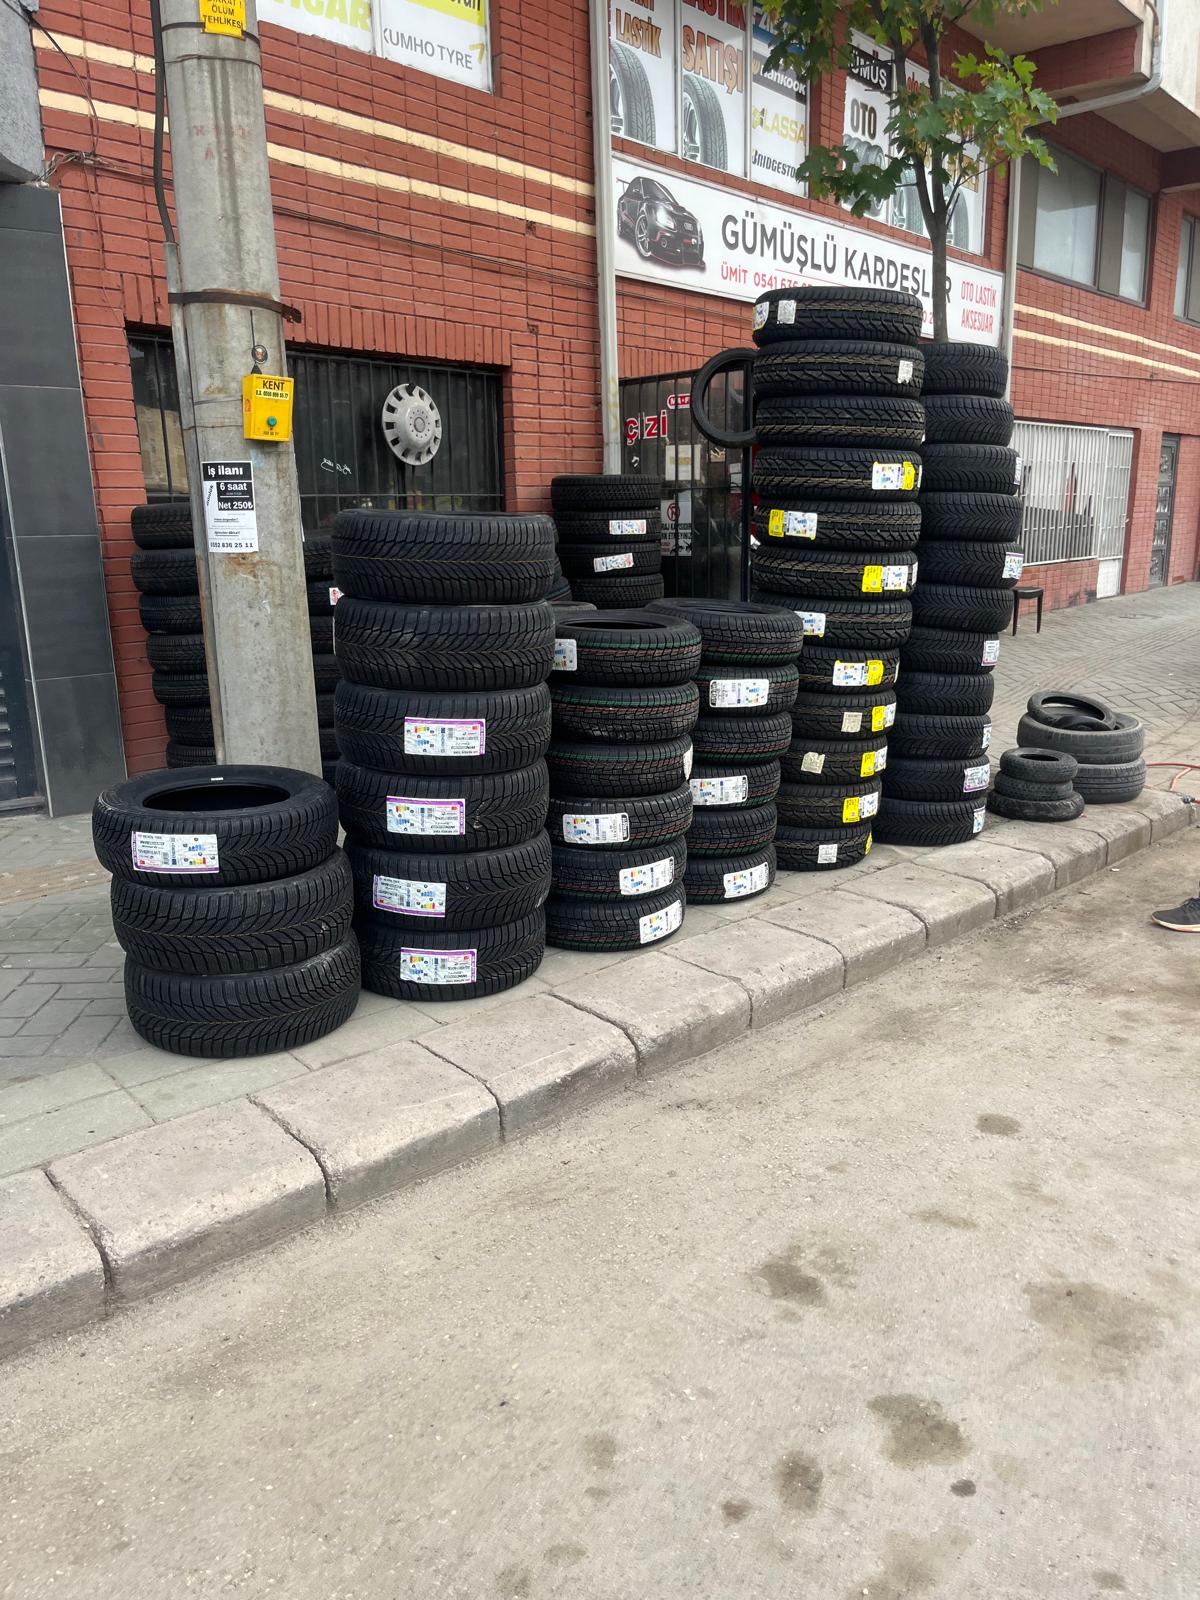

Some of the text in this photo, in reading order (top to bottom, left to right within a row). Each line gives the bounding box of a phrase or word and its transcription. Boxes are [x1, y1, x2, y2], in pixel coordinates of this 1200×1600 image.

[615, 8, 662, 58] LASTİK
[437, 44, 473, 70] TYRE
[682, 24, 744, 95] SATIŞI
[763, 108, 806, 144] LASSA
[850, 98, 877, 140] OTO
[721, 210, 952, 304] GÜMÜŞLÜ KARDEŞLR
[720, 261, 748, 285] ÜMİT
[753, 272, 778, 289] 0541
[960, 281, 998, 308] OTO LASTİK
[961, 308, 994, 333] AKSESUAR
[262, 380, 285, 391] KENT
[626, 409, 667, 446] ÇZİ
[208, 465, 244, 478] iş ilanı
[220, 482, 248, 491] 6 saat
[218, 501, 231, 510] Net
